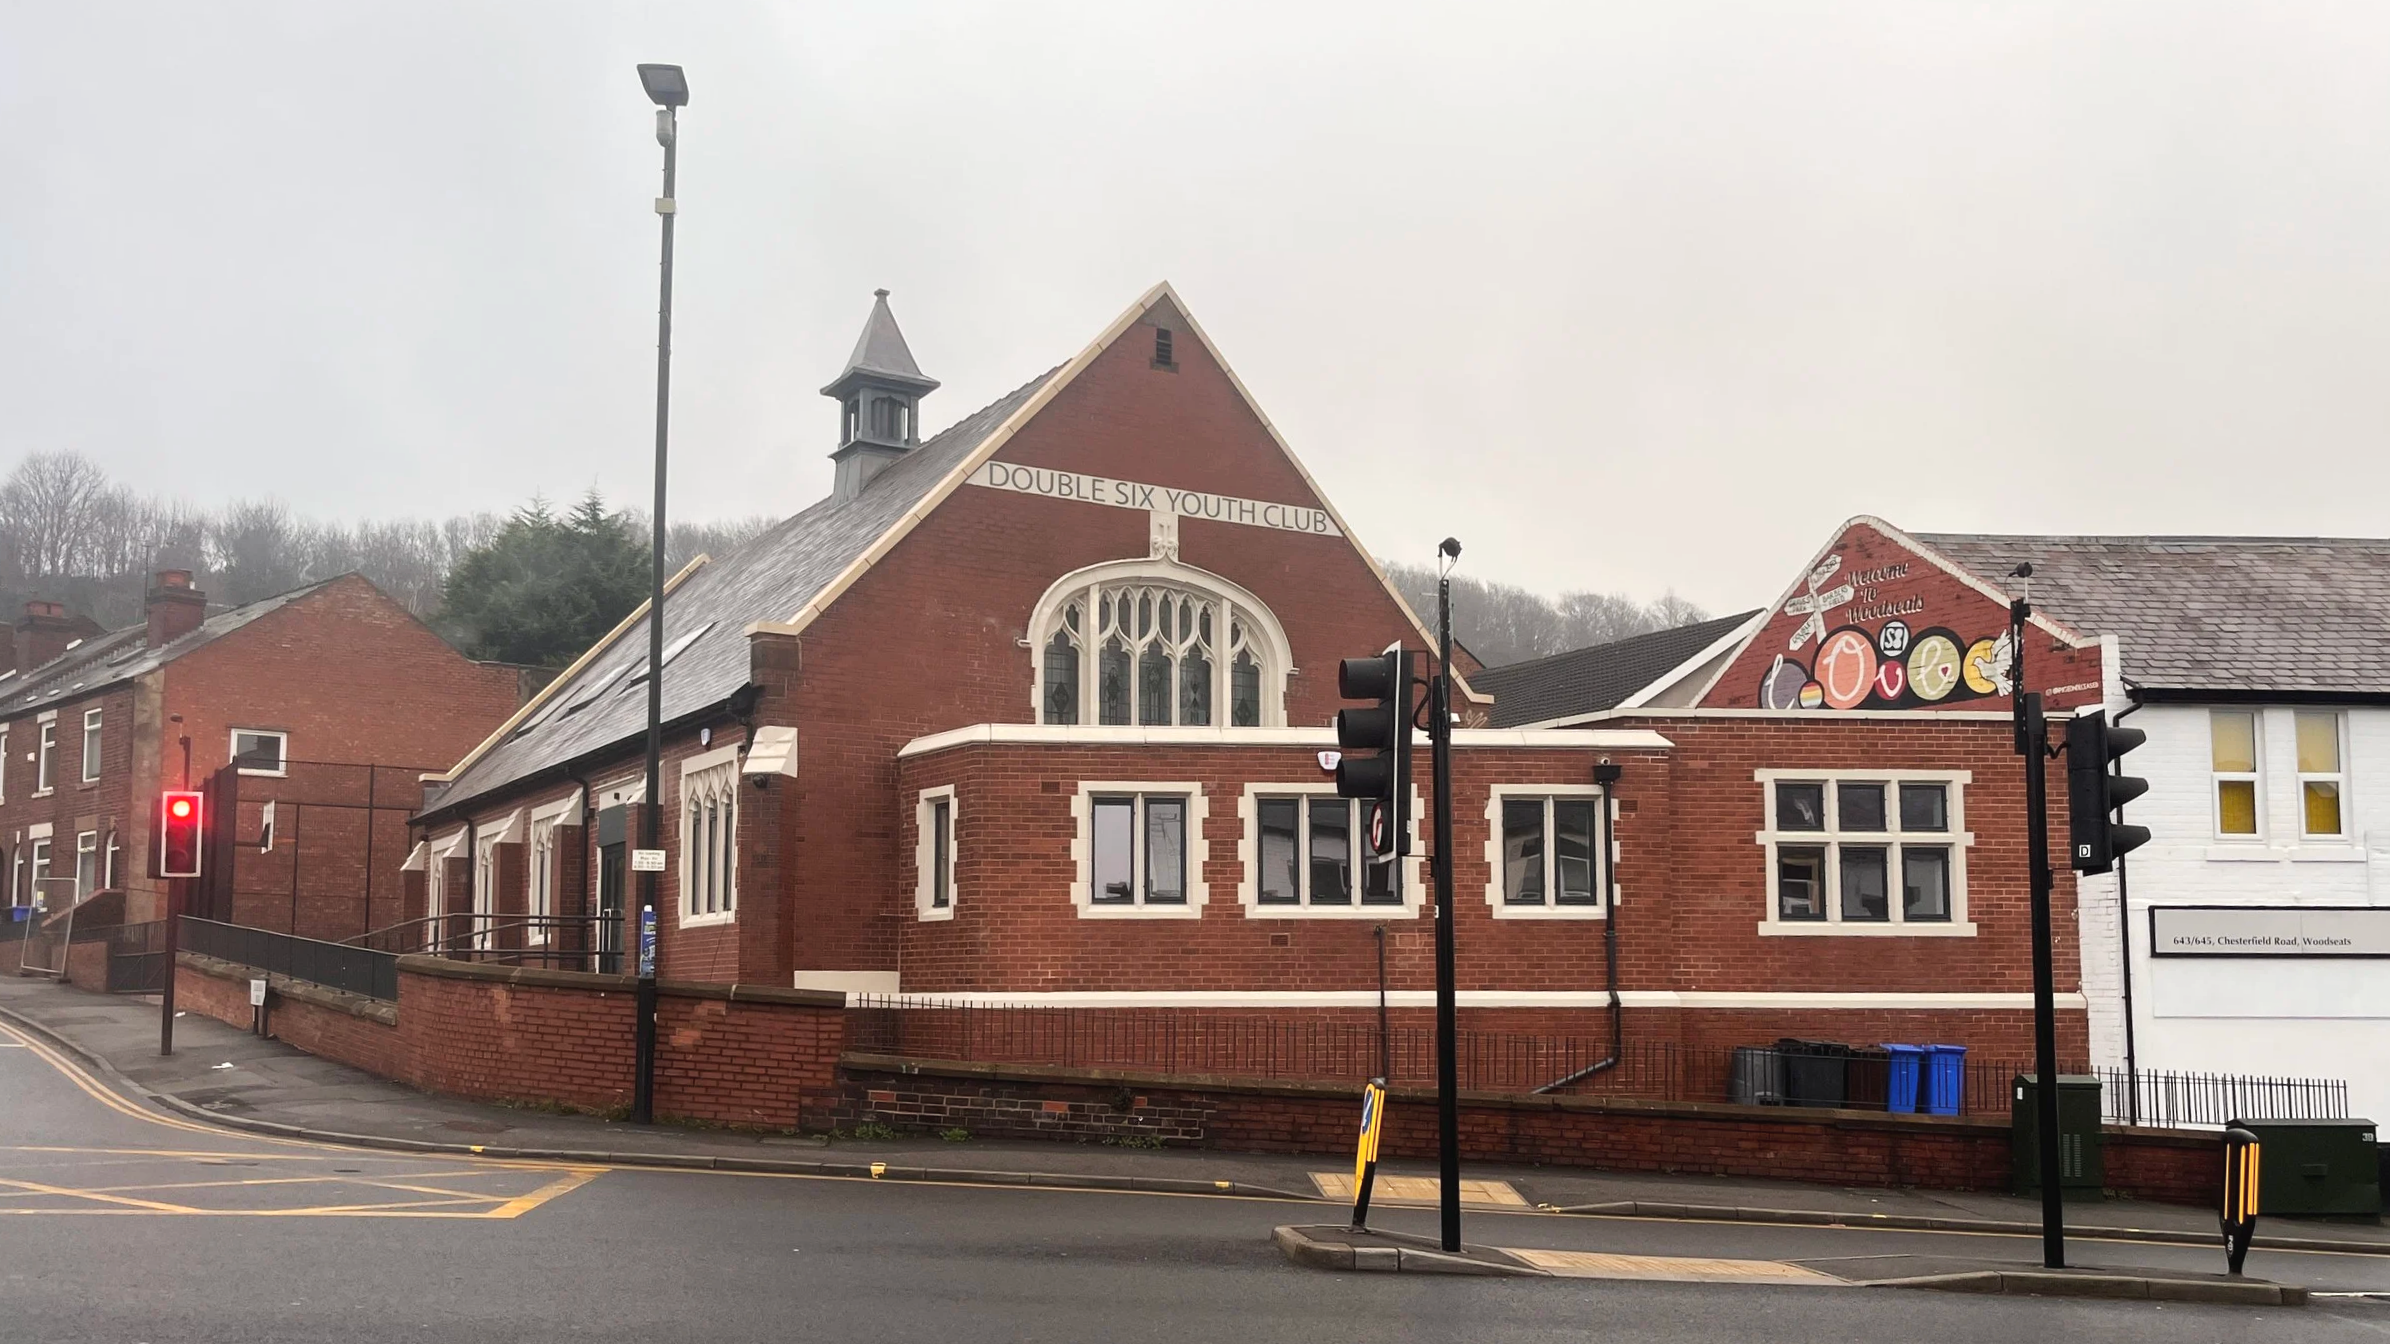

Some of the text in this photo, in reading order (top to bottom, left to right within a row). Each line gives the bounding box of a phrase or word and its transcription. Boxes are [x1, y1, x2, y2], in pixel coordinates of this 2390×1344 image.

[988, 462, 1328, 533] DOUBLE SIX YOUTH CLUB
[1844, 562, 1909, 587] Welcome
[1845, 594, 1924, 624] Woodseats
[2080, 845, 2089, 857] D
[2173, 936, 2352, 947] 643/645, Chesterfield Road, Woodseats
